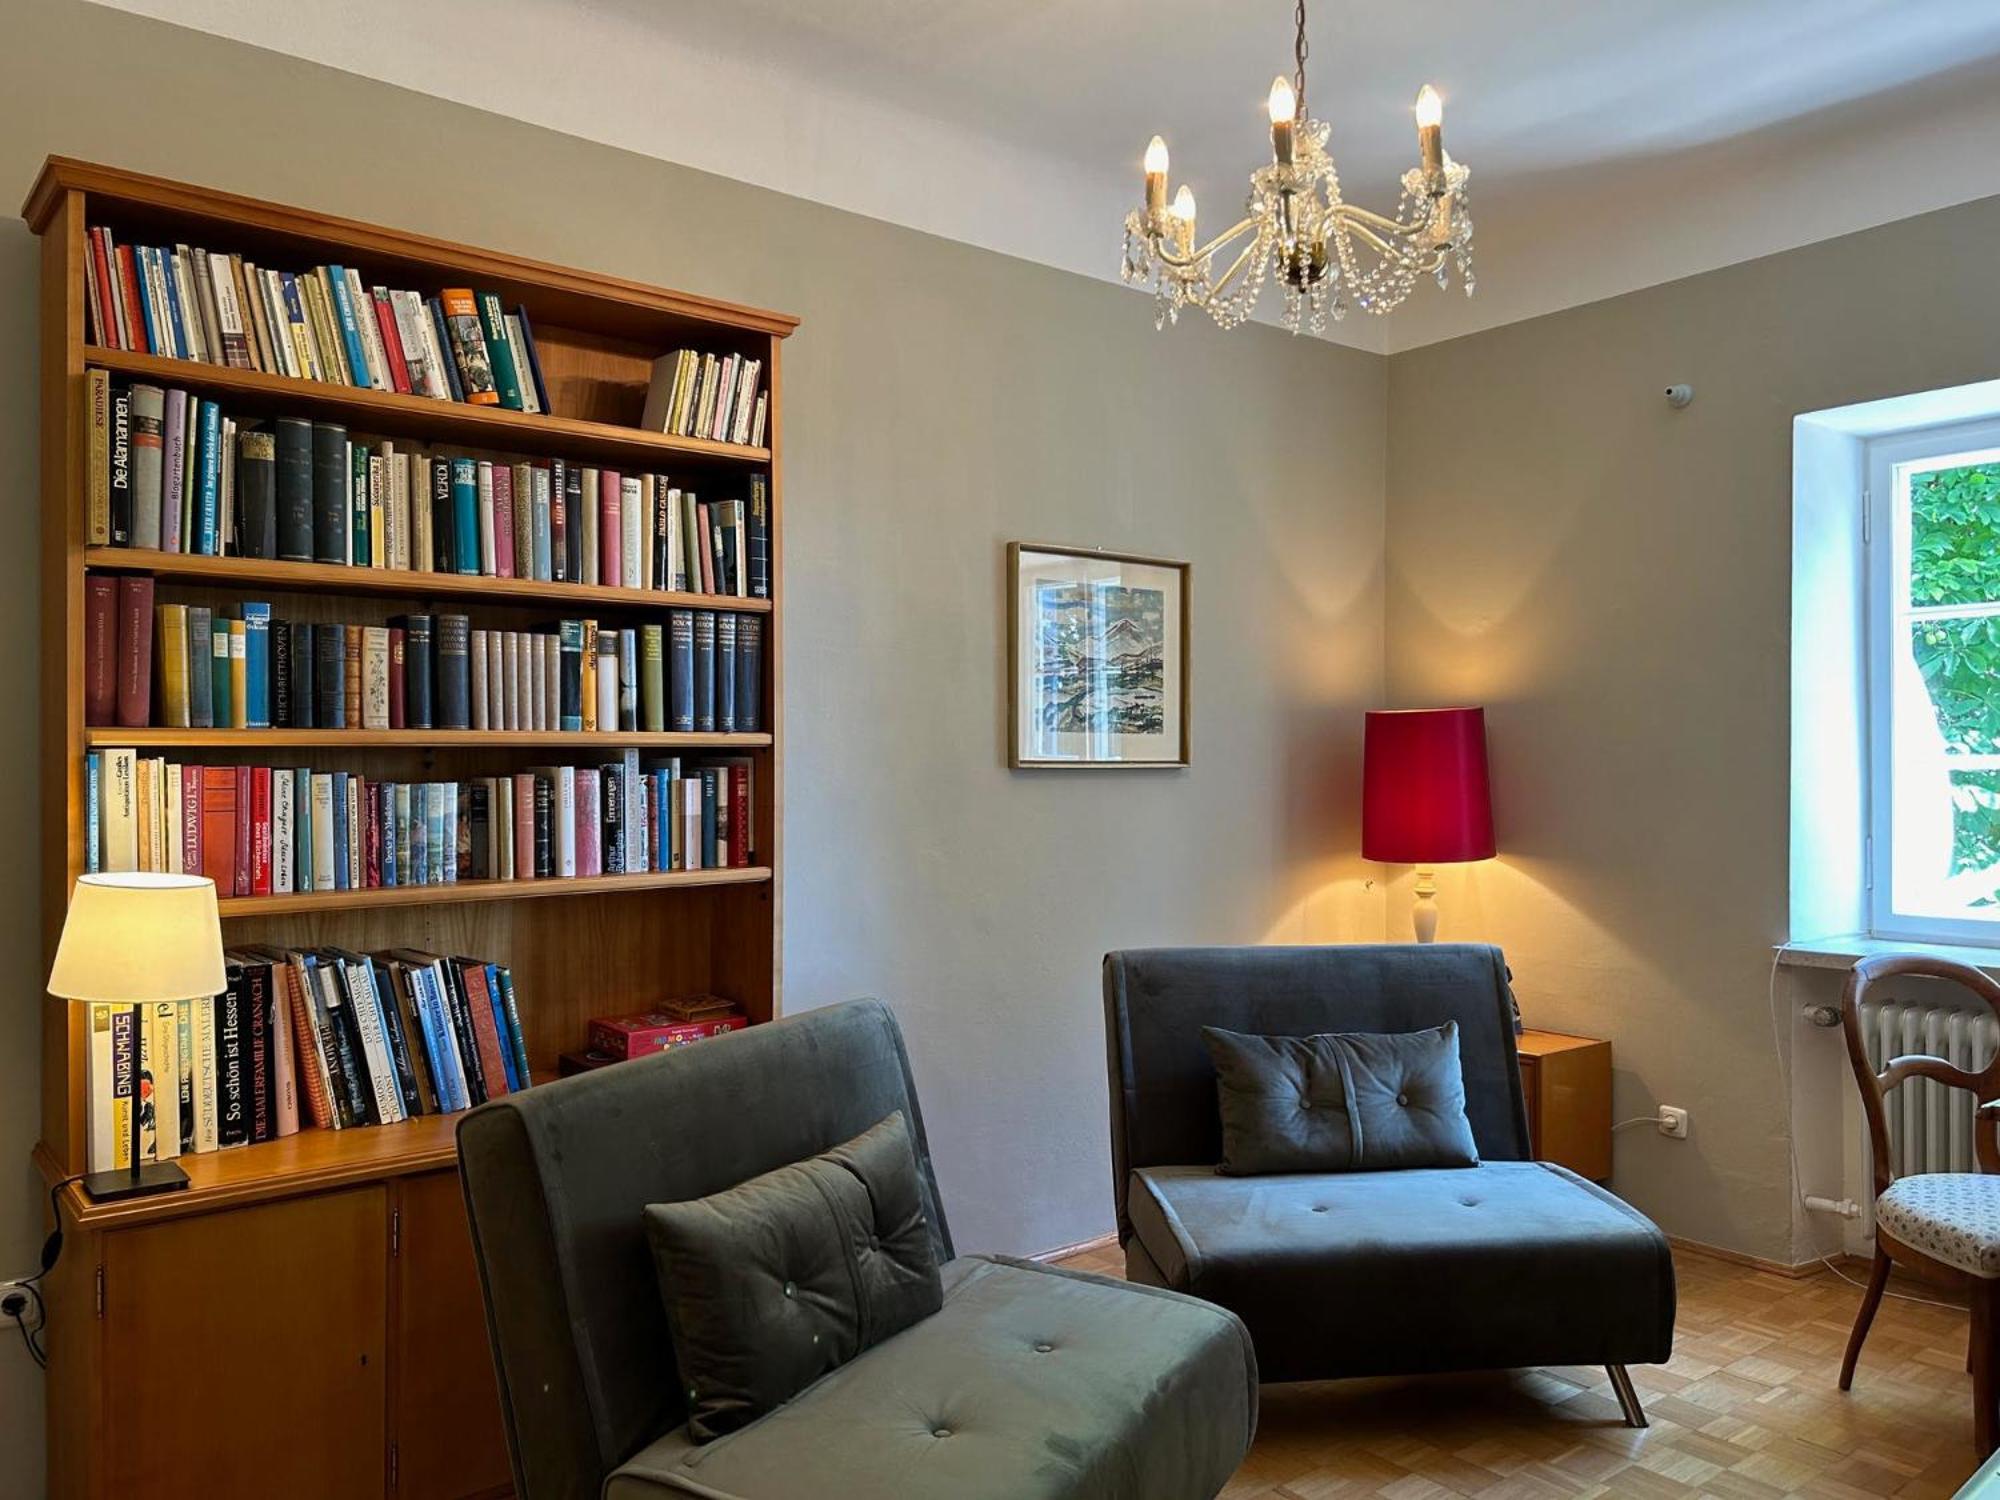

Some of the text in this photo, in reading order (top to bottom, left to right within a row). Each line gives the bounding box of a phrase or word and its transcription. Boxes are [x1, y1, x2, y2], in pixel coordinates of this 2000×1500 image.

[95, 378, 105, 429] PARADIESE
[114, 398, 128, 489] Die Alamannen
[437, 464, 449, 500] VERDI
[658, 510, 667, 537] PABLO
[606, 776, 616, 823] Erinnerungen
[186, 799, 197, 849] LUDWIG
[607, 845, 616, 872] Arthur
[115, 1014, 132, 1096] SCHWABING
[361, 1024, 373, 1044] DER
[372, 1024, 383, 1044] DER
[223, 992, 241, 1121] So schön ist Hessen
[250, 978, 267, 1139] DIE MALERFAMILIE CRANACH
[180, 1085, 190, 1104] LENI
[374, 1074, 388, 1117] DUMONT
[386, 1073, 399, 1115] DUMONT
